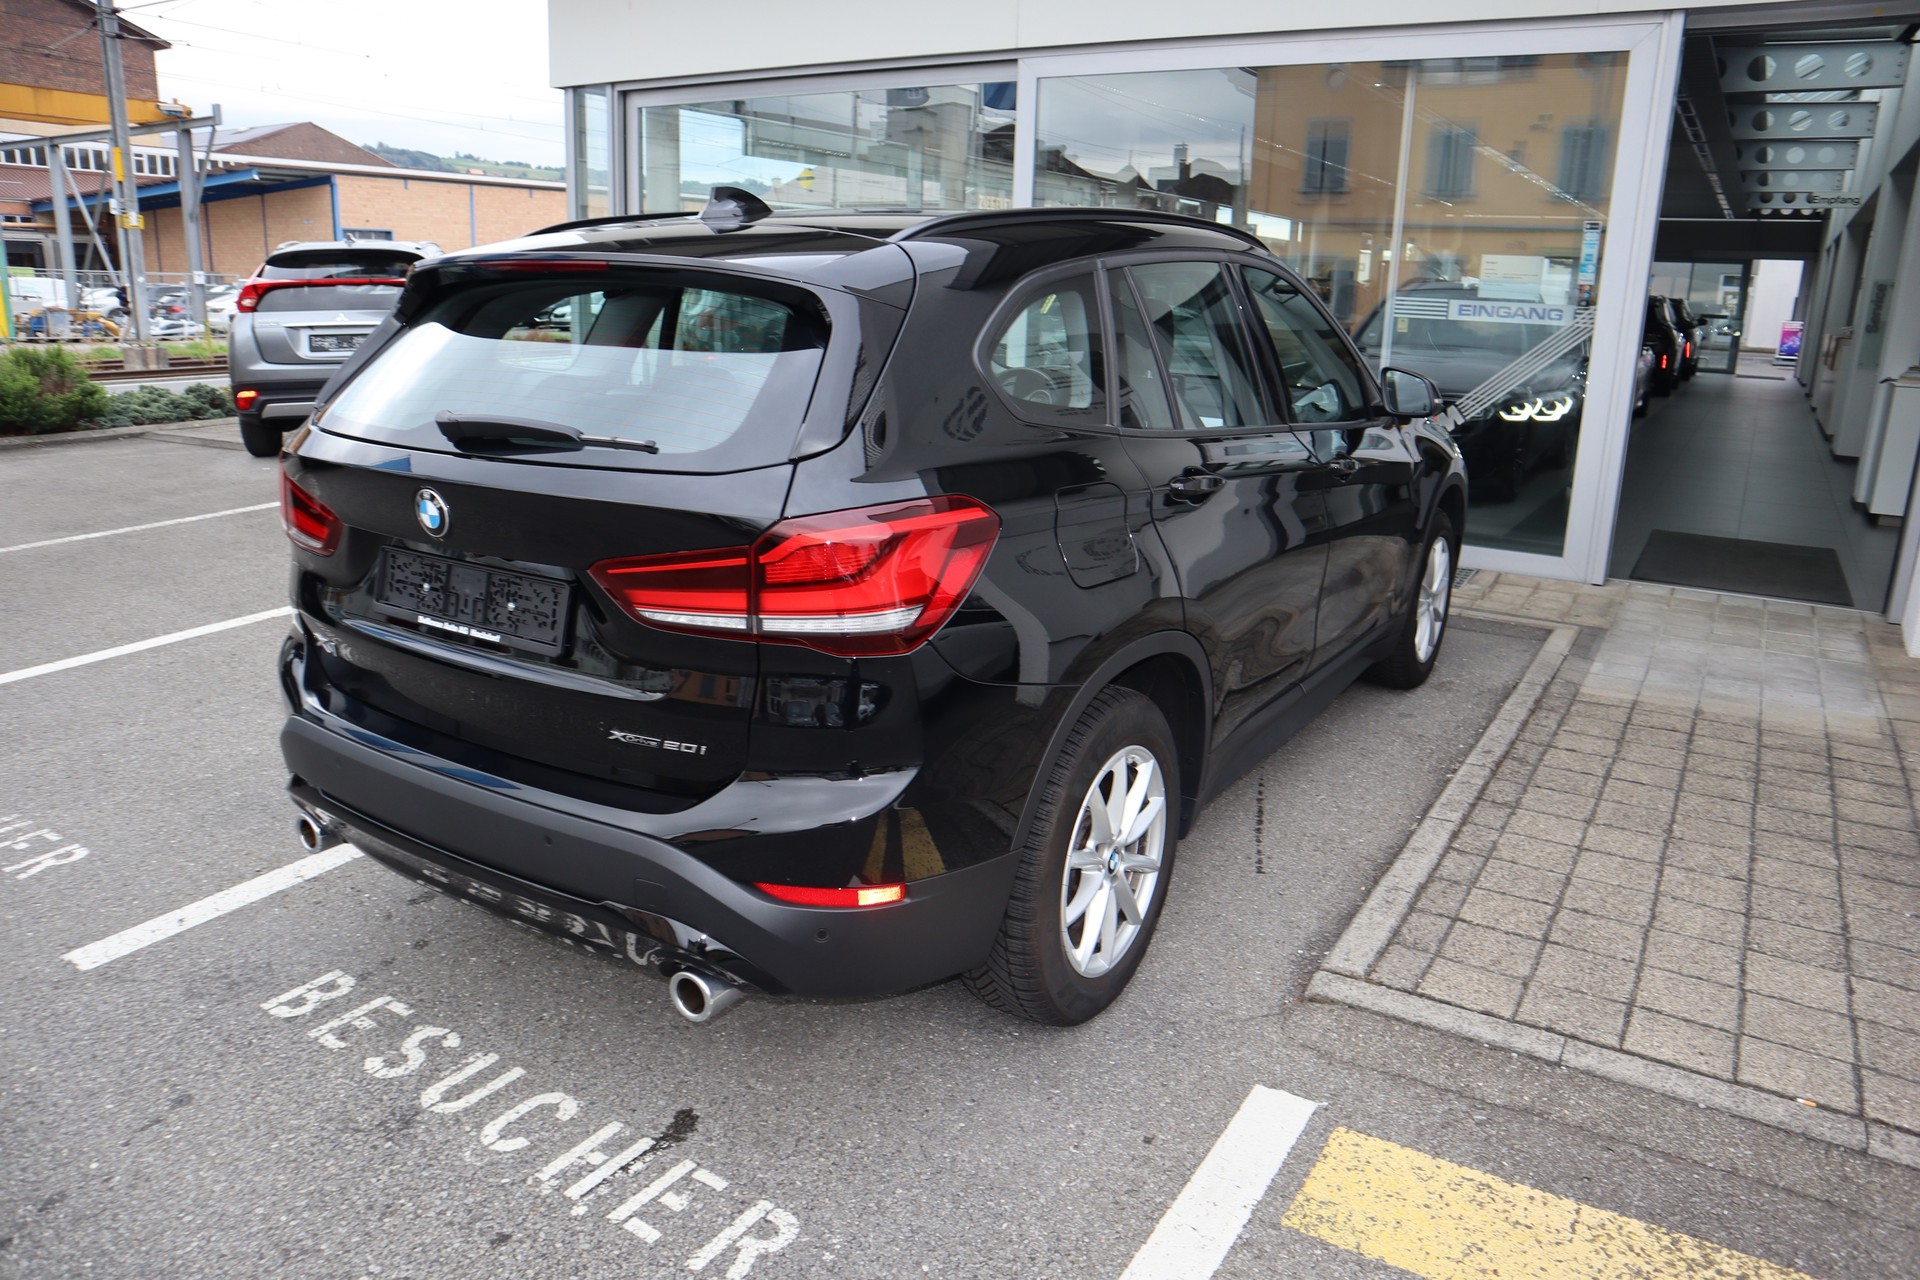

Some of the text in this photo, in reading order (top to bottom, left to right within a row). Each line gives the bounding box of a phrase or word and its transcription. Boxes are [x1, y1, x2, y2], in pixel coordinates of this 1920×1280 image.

[1811, 195, 1860, 206] Empfang
[1457, 303, 1564, 321] EINGANG
[1865, 283, 1888, 334] Service
[260, 969, 800, 1280] BESUCHER
